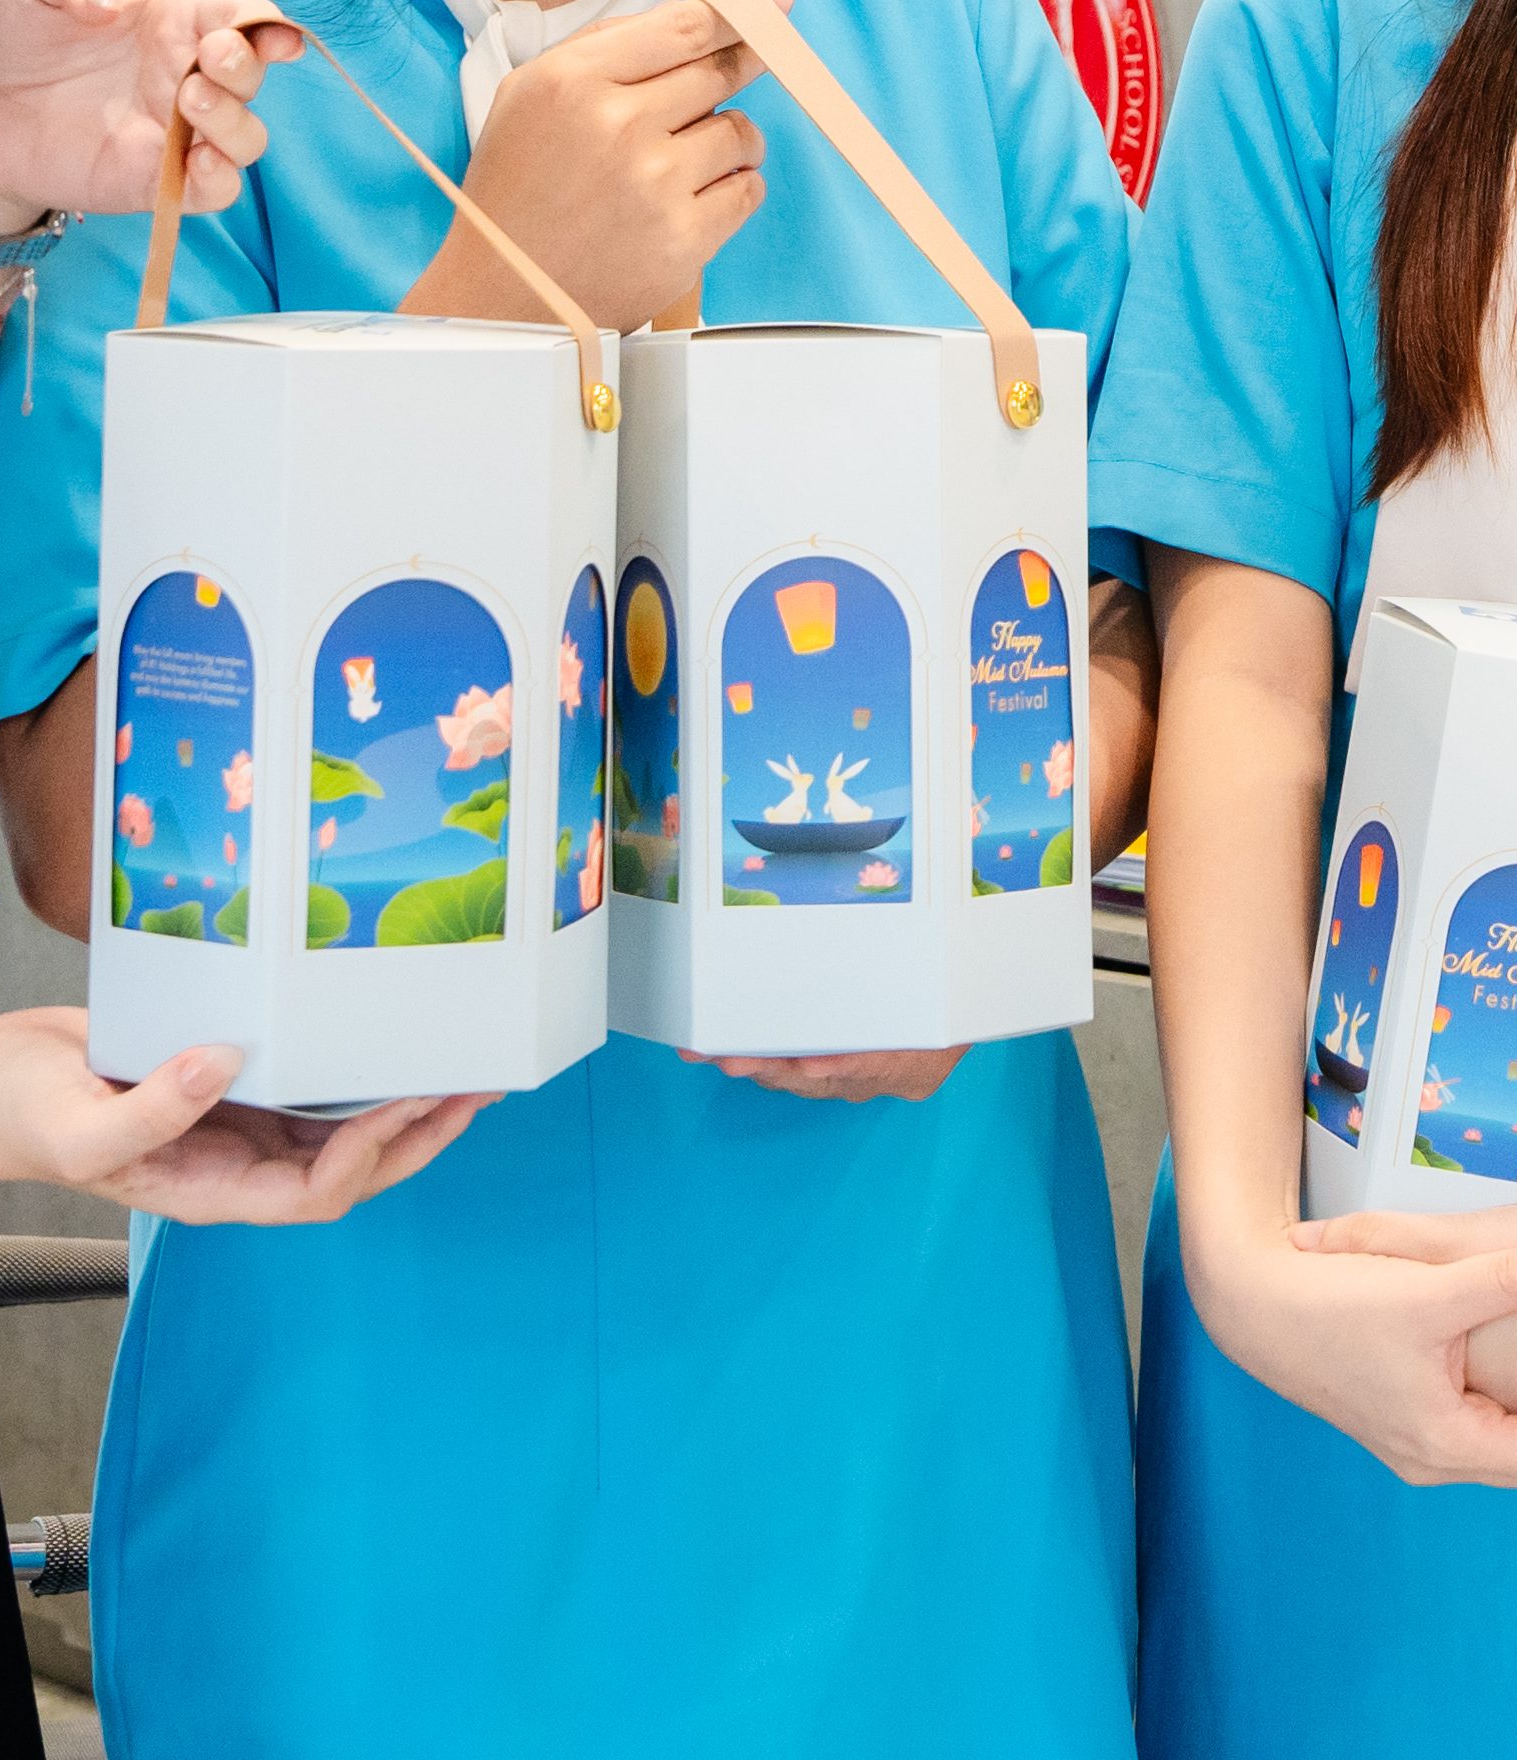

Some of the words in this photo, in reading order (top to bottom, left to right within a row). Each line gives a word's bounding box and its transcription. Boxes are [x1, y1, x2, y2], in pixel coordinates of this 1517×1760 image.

[1119, 7, 1145, 151] SCHOOL
[991, 619, 1043, 654] Happy
[971, 654, 1006, 685] Mid
[1009, 651, 1069, 682] Autumn
[989, 685, 1048, 713] Festival
[1442, 949, 1504, 979] Mid
